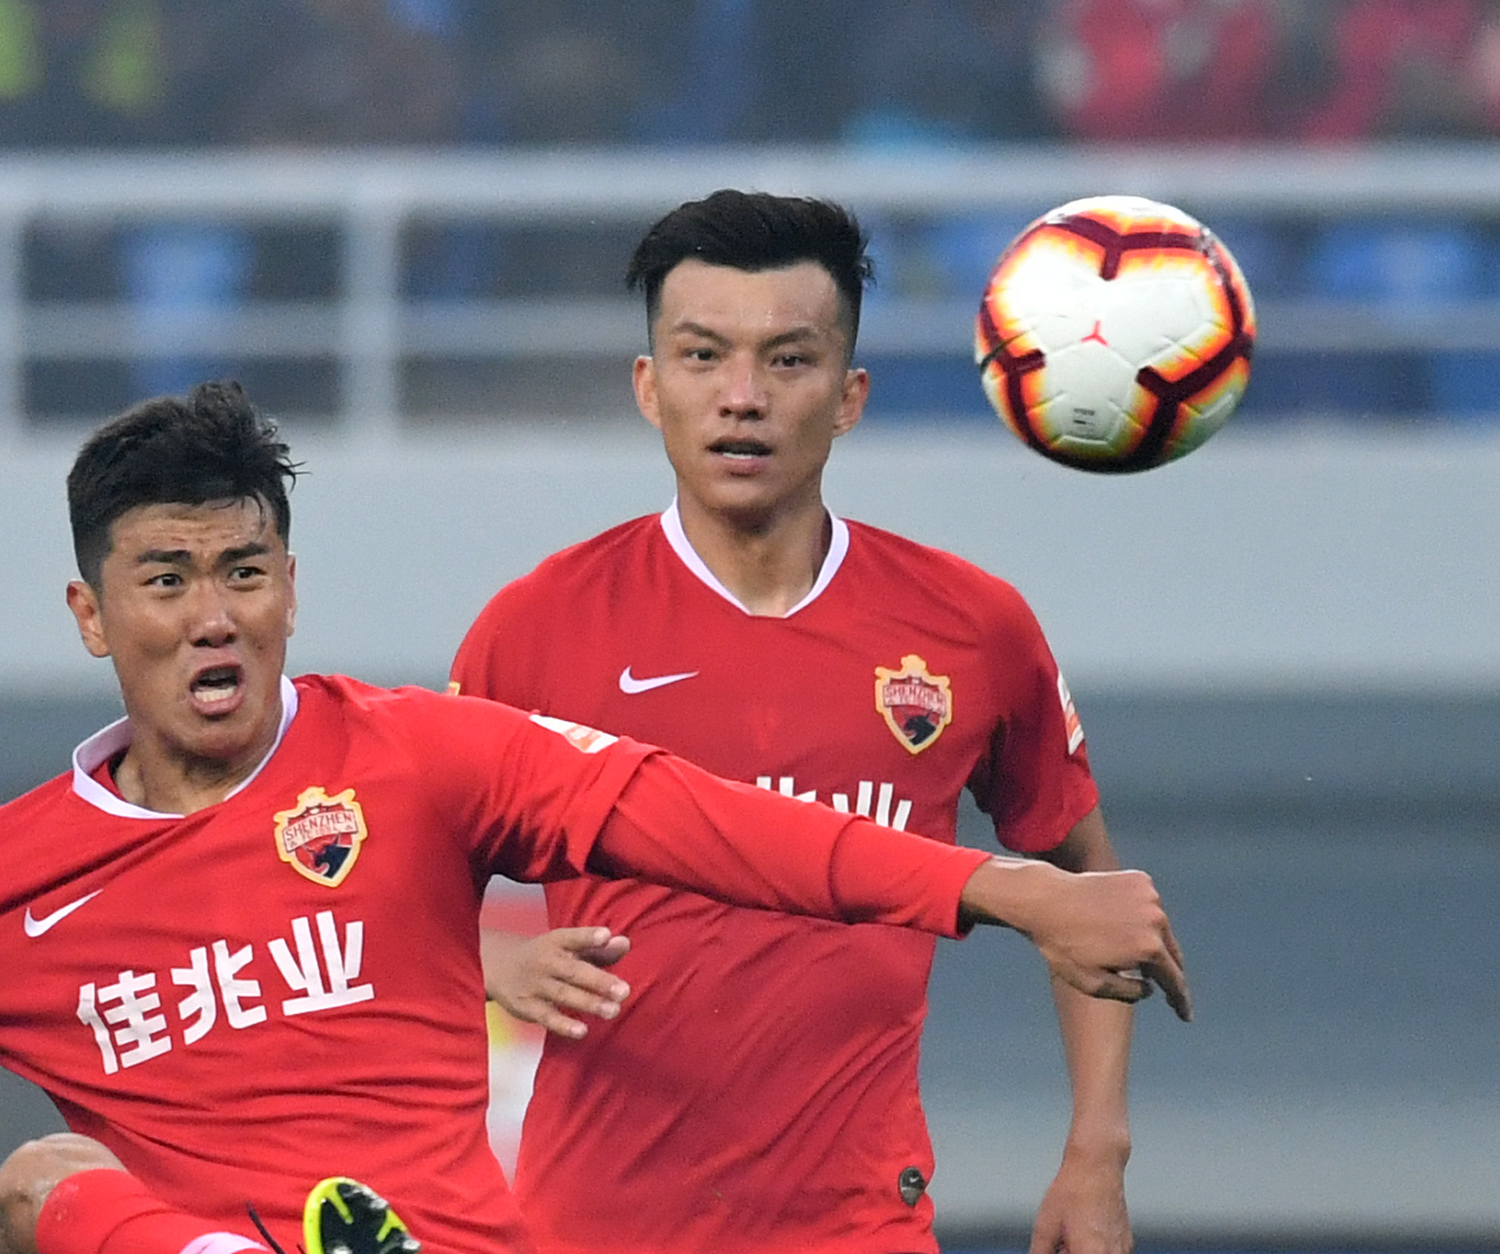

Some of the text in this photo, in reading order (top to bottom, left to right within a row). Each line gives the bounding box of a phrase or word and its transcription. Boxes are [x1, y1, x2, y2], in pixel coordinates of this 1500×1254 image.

[285, 812, 352, 841] SHENZHEN
[76, 910, 375, 1075] 佳兆业
